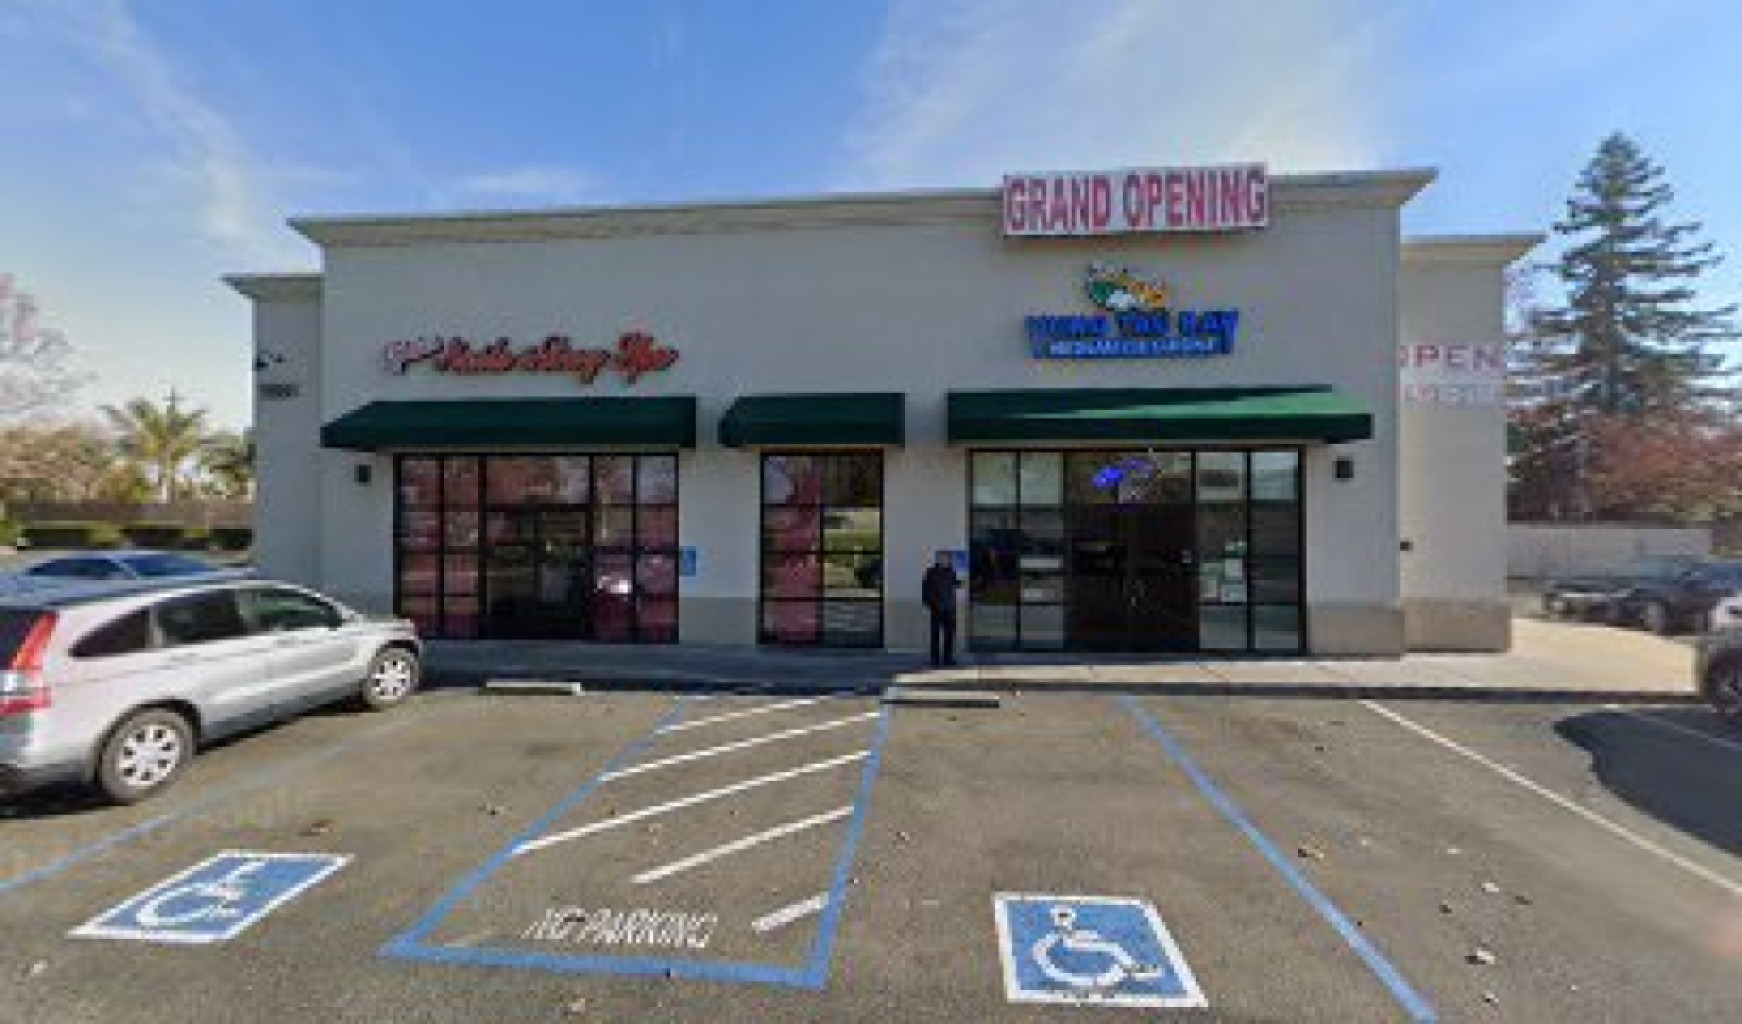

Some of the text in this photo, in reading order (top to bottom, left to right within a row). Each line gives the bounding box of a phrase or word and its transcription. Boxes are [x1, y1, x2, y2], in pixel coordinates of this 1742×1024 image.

[1006, 167, 1265, 232] GRAND OPENING
[577, 906, 719, 948] PARKING
